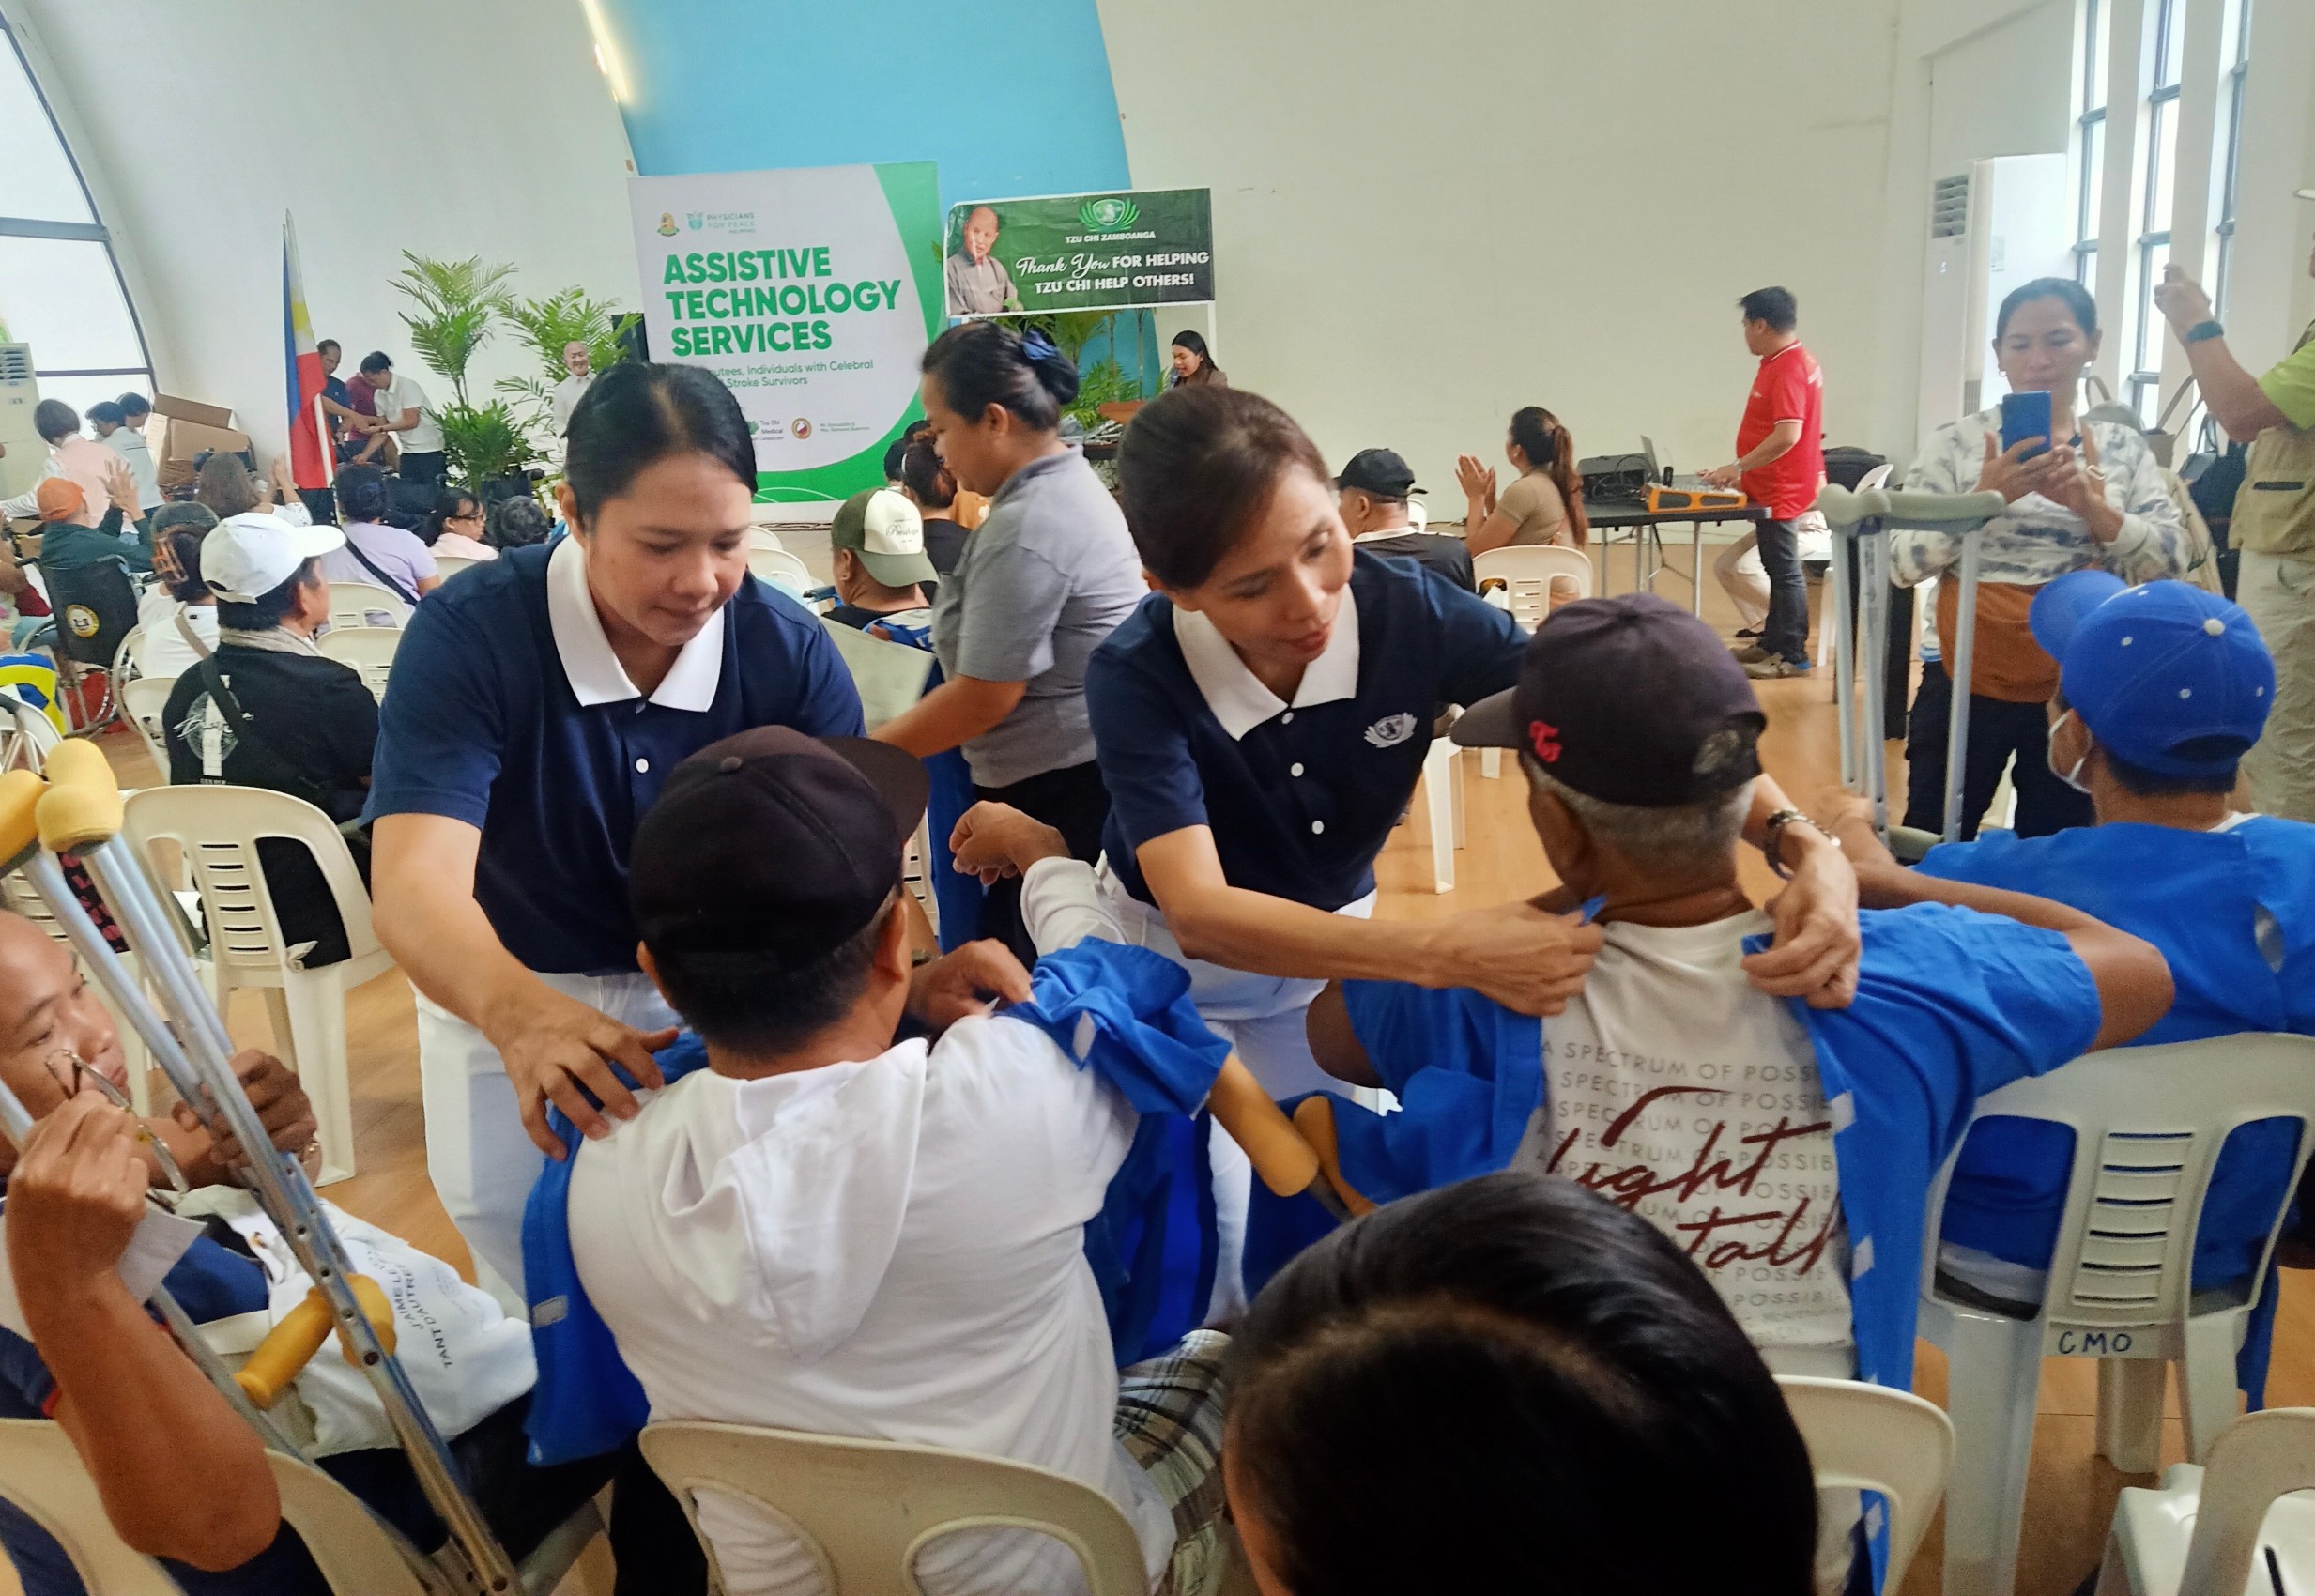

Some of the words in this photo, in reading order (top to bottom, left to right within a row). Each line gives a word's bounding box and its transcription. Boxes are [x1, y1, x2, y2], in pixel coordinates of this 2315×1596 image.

[1065, 234, 1082, 244] TZU
[1083, 233, 1099, 243] CHI
[1100, 231, 1156, 241] ZAMBOANGA
[664, 247, 832, 284] ASSISTIVE
[1015, 255, 1067, 277] Thank
[1070, 253, 1111, 278] You
[1112, 255, 1142, 269] FOR
[1145, 251, 1209, 267] HELPING
[1035, 282, 1062, 294] TZU
[1066, 280, 1091, 292] CHI
[1094, 278, 1129, 291] HELP
[1133, 273, 1194, 288] OTHERS!
[665, 279, 901, 321] TECHNOLOGY
[671, 320, 833, 357] SERVICES
[711, 367, 745, 378] utees,
[747, 364, 802, 375] Individuals
[805, 363, 828, 372] with
[830, 359, 874, 371] Celebral
[727, 377, 759, 388] Stroke
[762, 376, 808, 387] Survivors
[1564, 1042, 1687, 1077] SPECTRUM
[1698, 1063, 1732, 1079] OF
[1560, 1071, 1684, 1104] SPECTRM
[1557, 1100, 1683, 1131] SPECRUM
[430, 1327, 452, 1369] TANT
[2059, 1330, 2132, 1354] CMO
